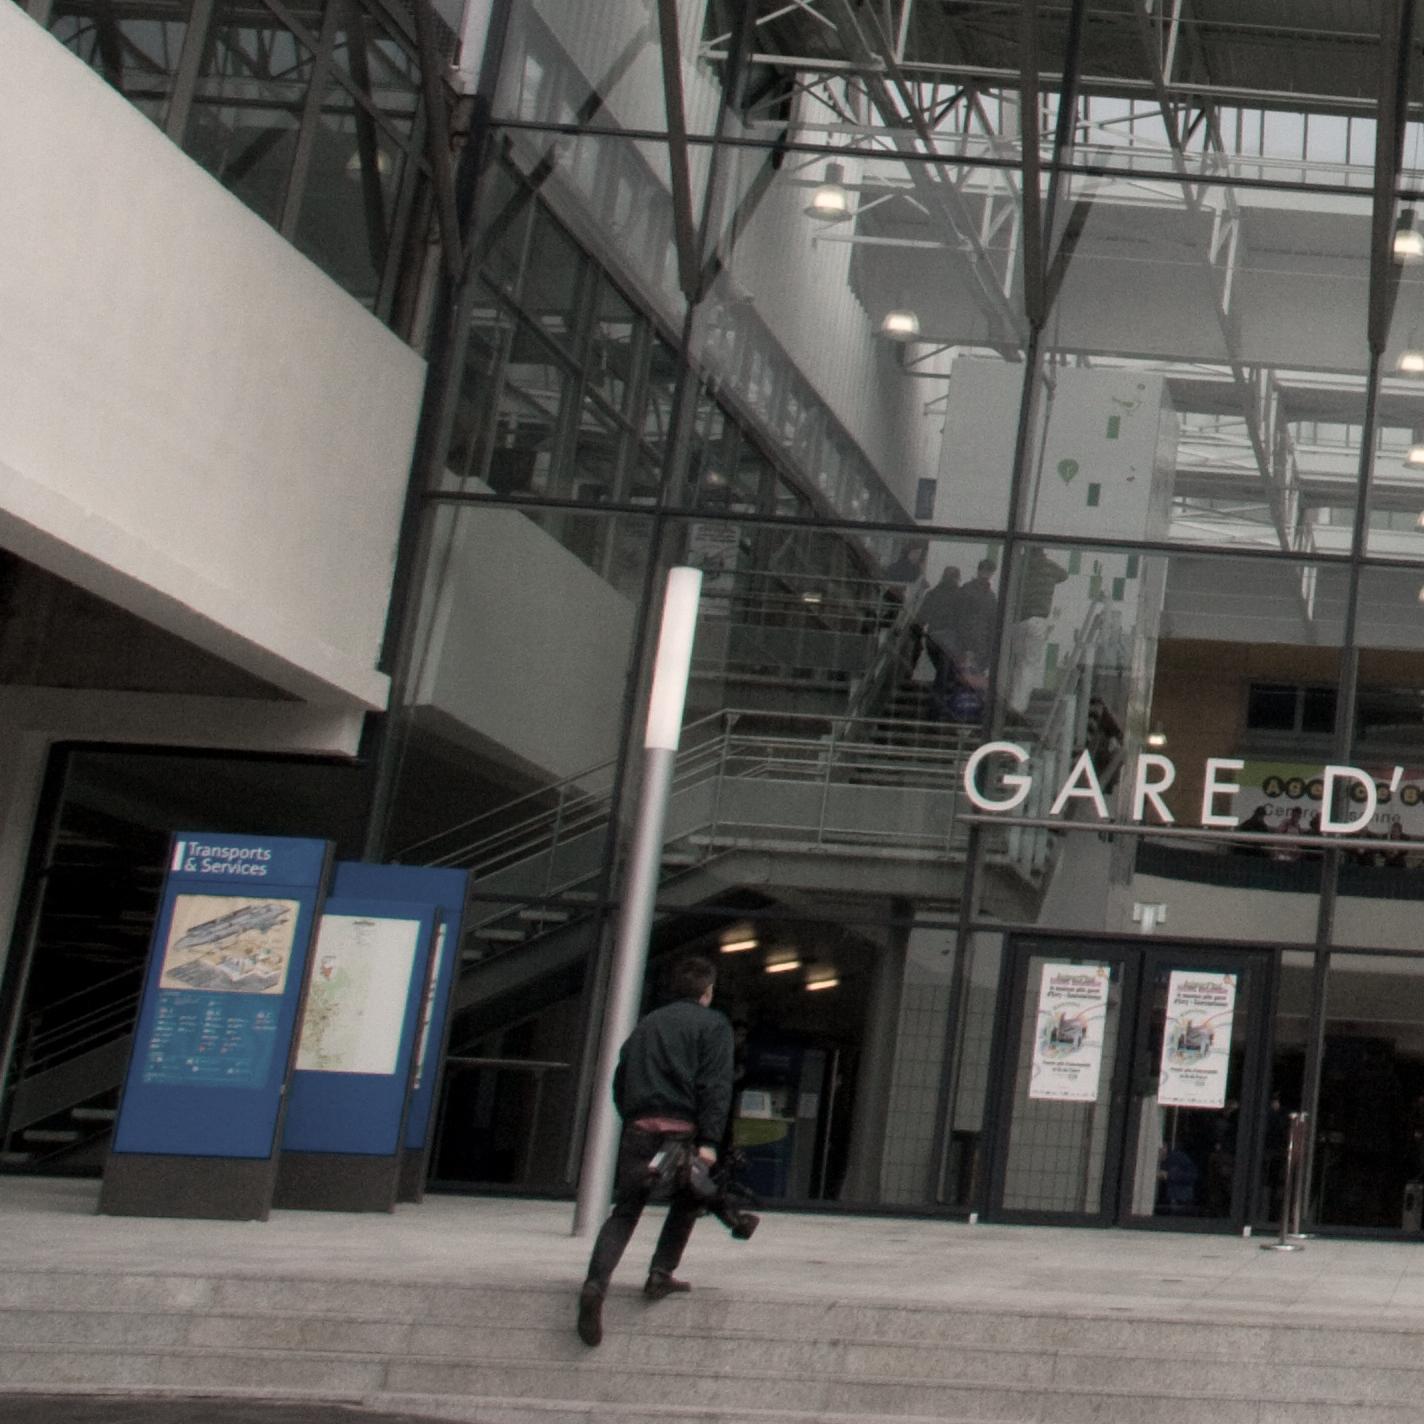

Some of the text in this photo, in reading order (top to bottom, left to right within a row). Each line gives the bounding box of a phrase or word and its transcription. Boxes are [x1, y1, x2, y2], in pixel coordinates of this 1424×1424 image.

[963, 740, 1246, 827] GARE
[188, 841, 272, 861] Transports
[184, 857, 267, 875] & Services
